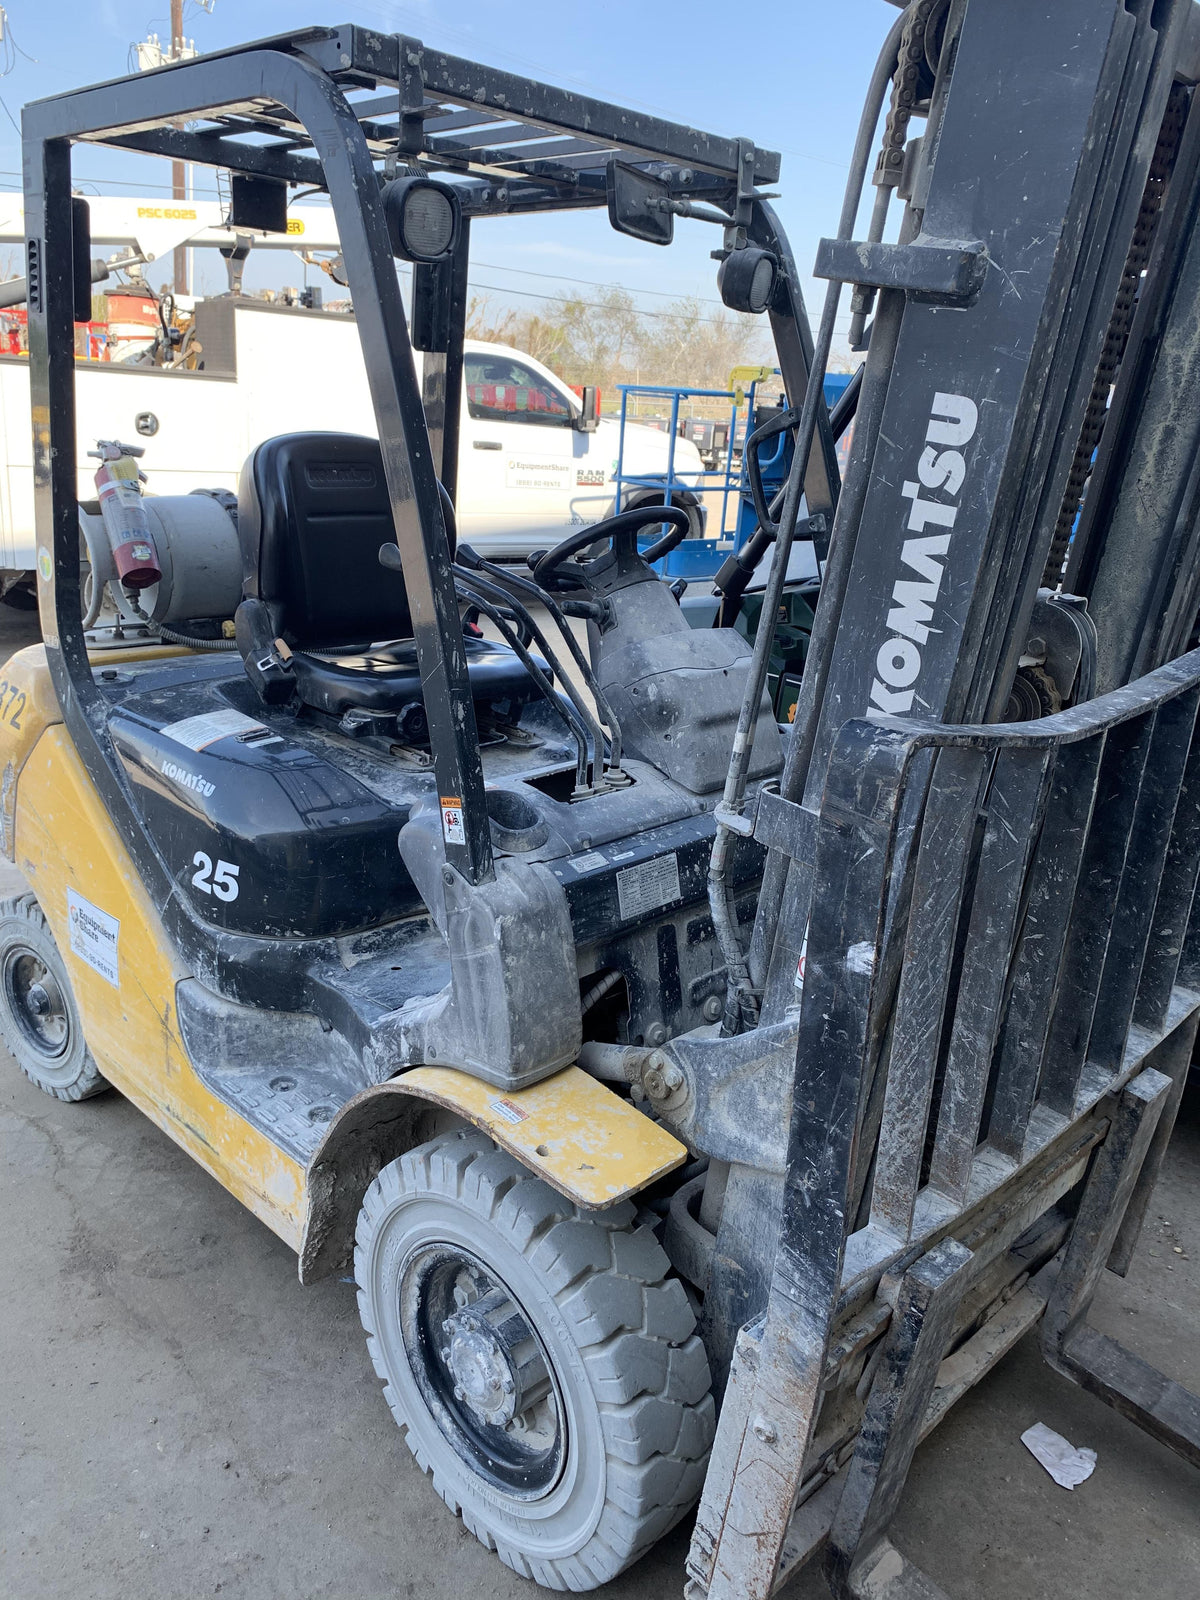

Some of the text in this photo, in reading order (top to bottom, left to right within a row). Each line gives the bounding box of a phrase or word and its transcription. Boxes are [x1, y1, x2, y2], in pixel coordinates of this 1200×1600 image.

[137, 207, 197, 220] PSC 6025
[866, 391, 979, 718] KOMATSU
[161, 760, 216, 798] KOMATSU
[191, 851, 240, 903] 25
[79, 907, 116, 944] Equipment
[79, 920, 99, 943] Share
